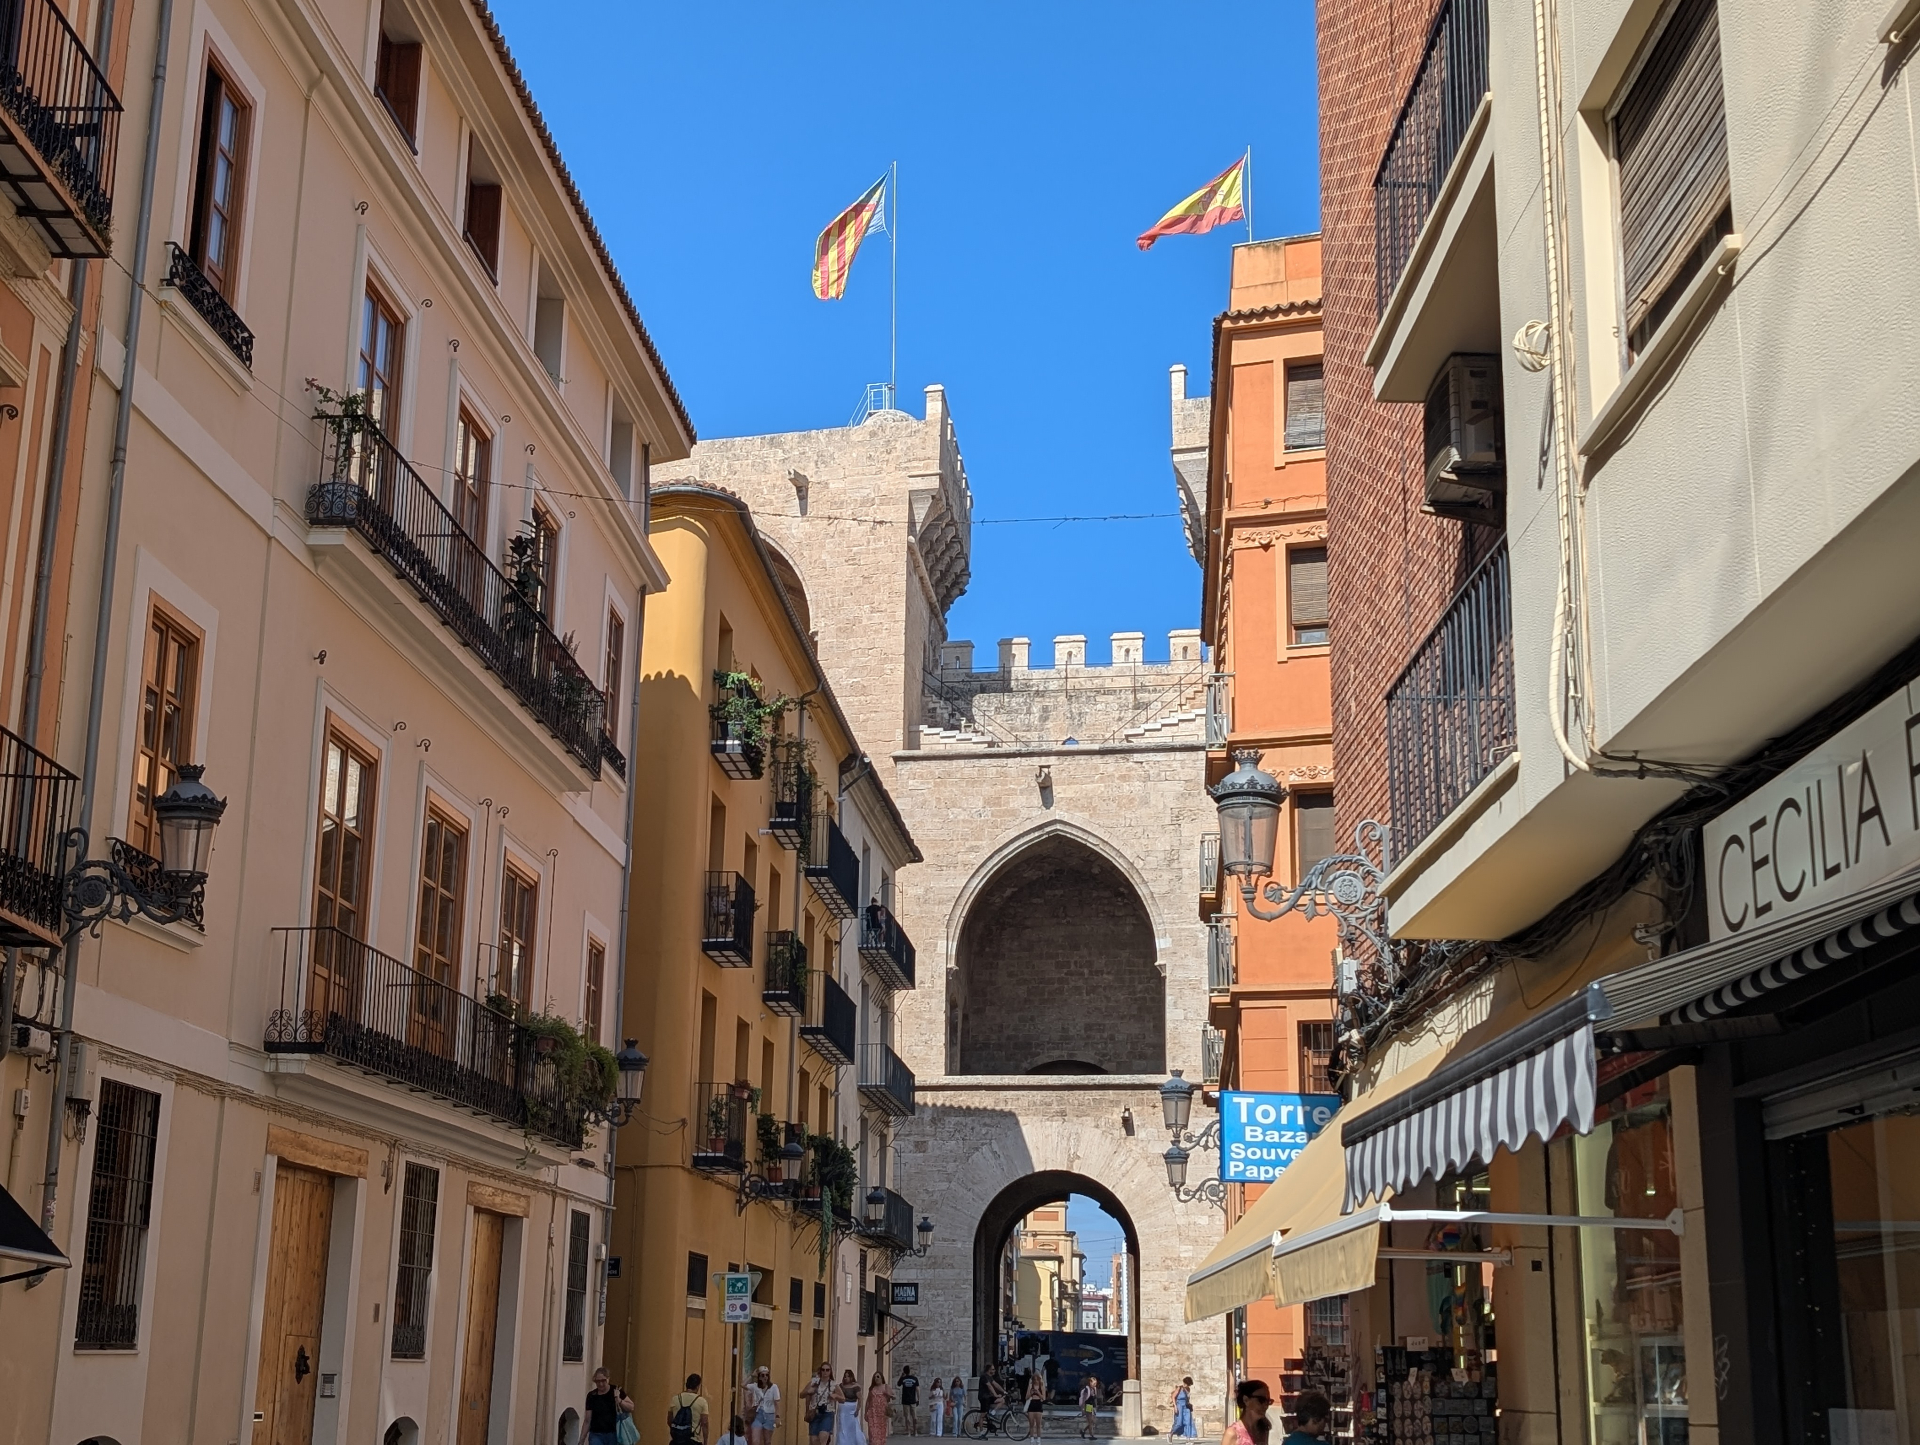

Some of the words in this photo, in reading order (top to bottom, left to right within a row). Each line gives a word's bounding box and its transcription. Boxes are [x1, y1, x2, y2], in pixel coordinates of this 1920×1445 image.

[1719, 749, 1891, 933] CECILIA
[1232, 1097, 1331, 1126] Torre
[1230, 1142, 1302, 1160] Souve
[1229, 1161, 1288, 1180] Pape
